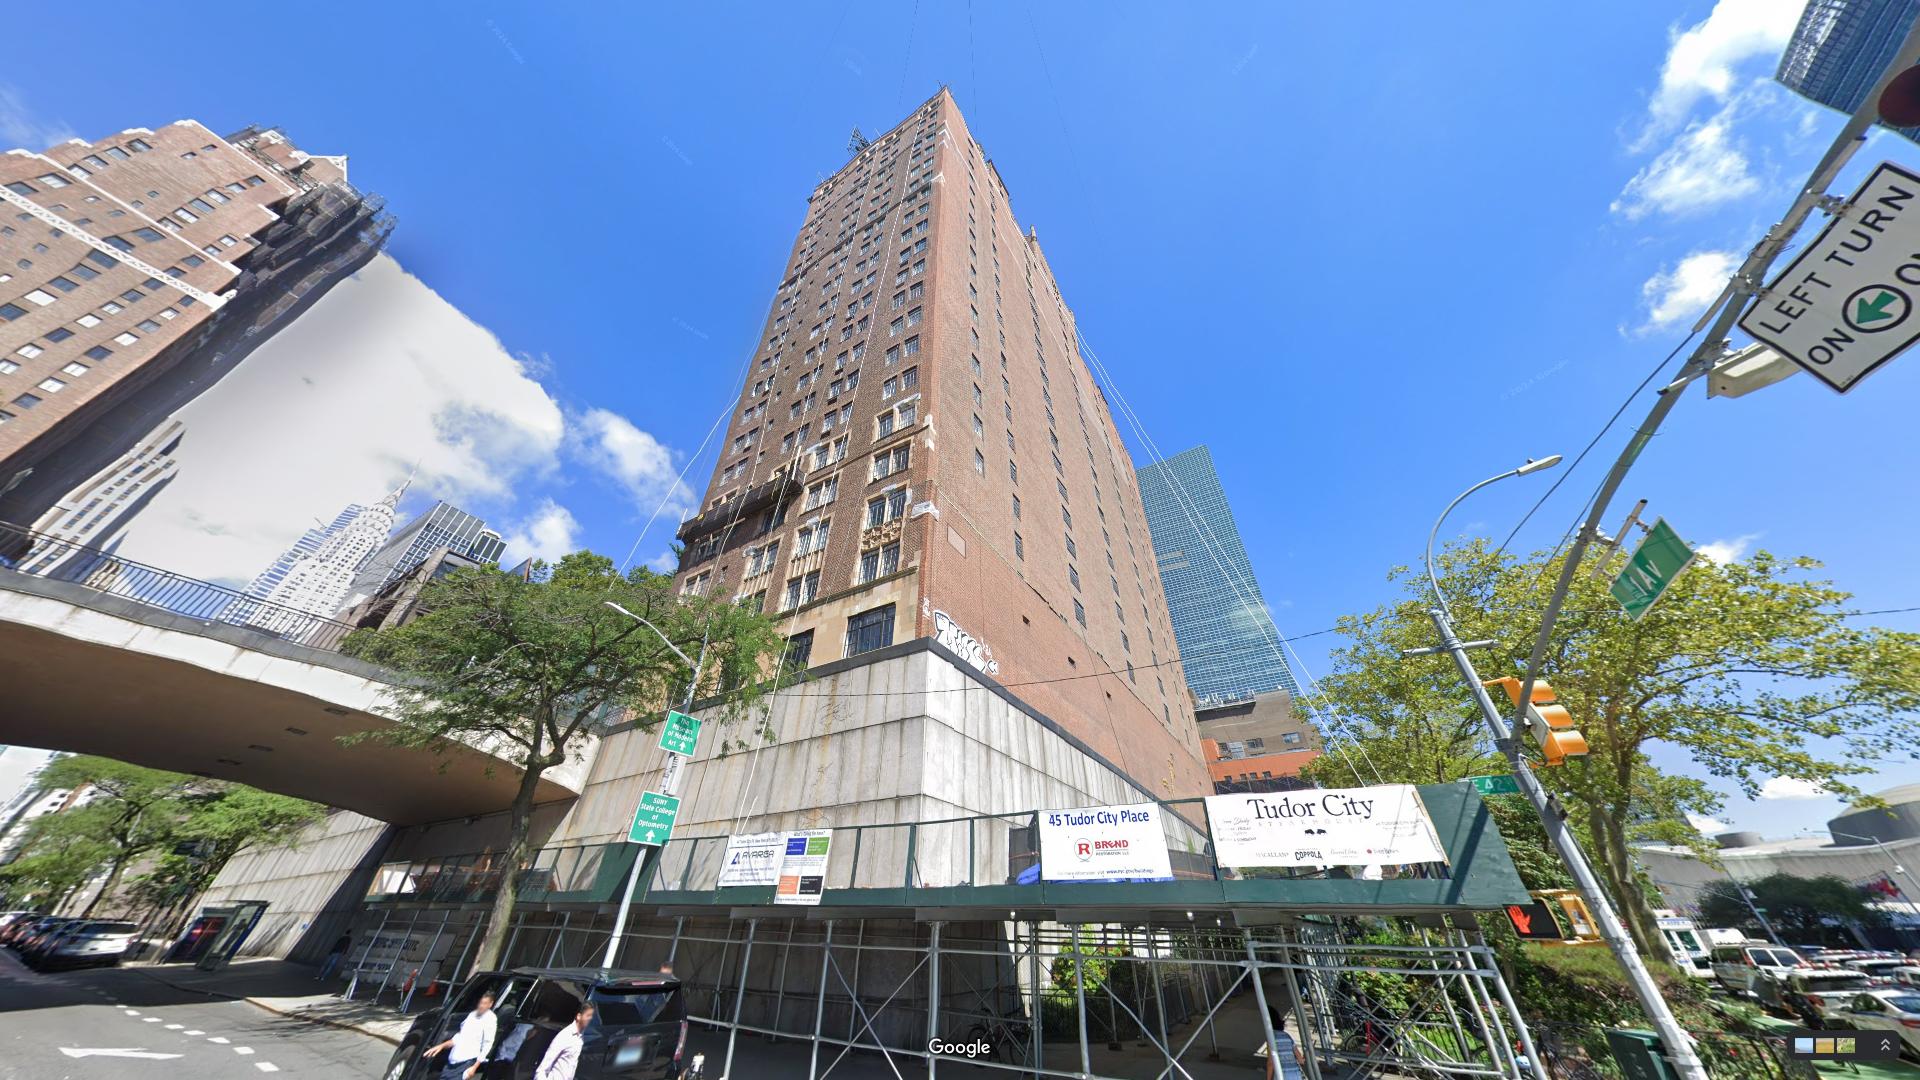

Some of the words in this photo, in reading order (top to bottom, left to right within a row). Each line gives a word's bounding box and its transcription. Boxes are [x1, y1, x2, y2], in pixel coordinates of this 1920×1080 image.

[1758, 271, 1832, 334] LEFT
[1824, 185, 1915, 266] TURN
[1808, 327, 1856, 365] ON
[674, 732, 693, 743] Modern
[641, 803, 655, 811] State
[656, 806, 676, 816] College
[1247, 797, 1315, 819] Tudor
[1322, 794, 1373, 819] City
[1049, 814, 1061, 826] 45
[1064, 813, 1095, 826] Tudor
[1097, 811, 1118, 826] City
[1121, 810, 1149, 823] Place
[638, 820, 668, 830] Optometry
[1078, 843, 1090, 855] R
[1094, 840, 1128, 849] BREND
[1295, 851, 1323, 860] COPPOLA
